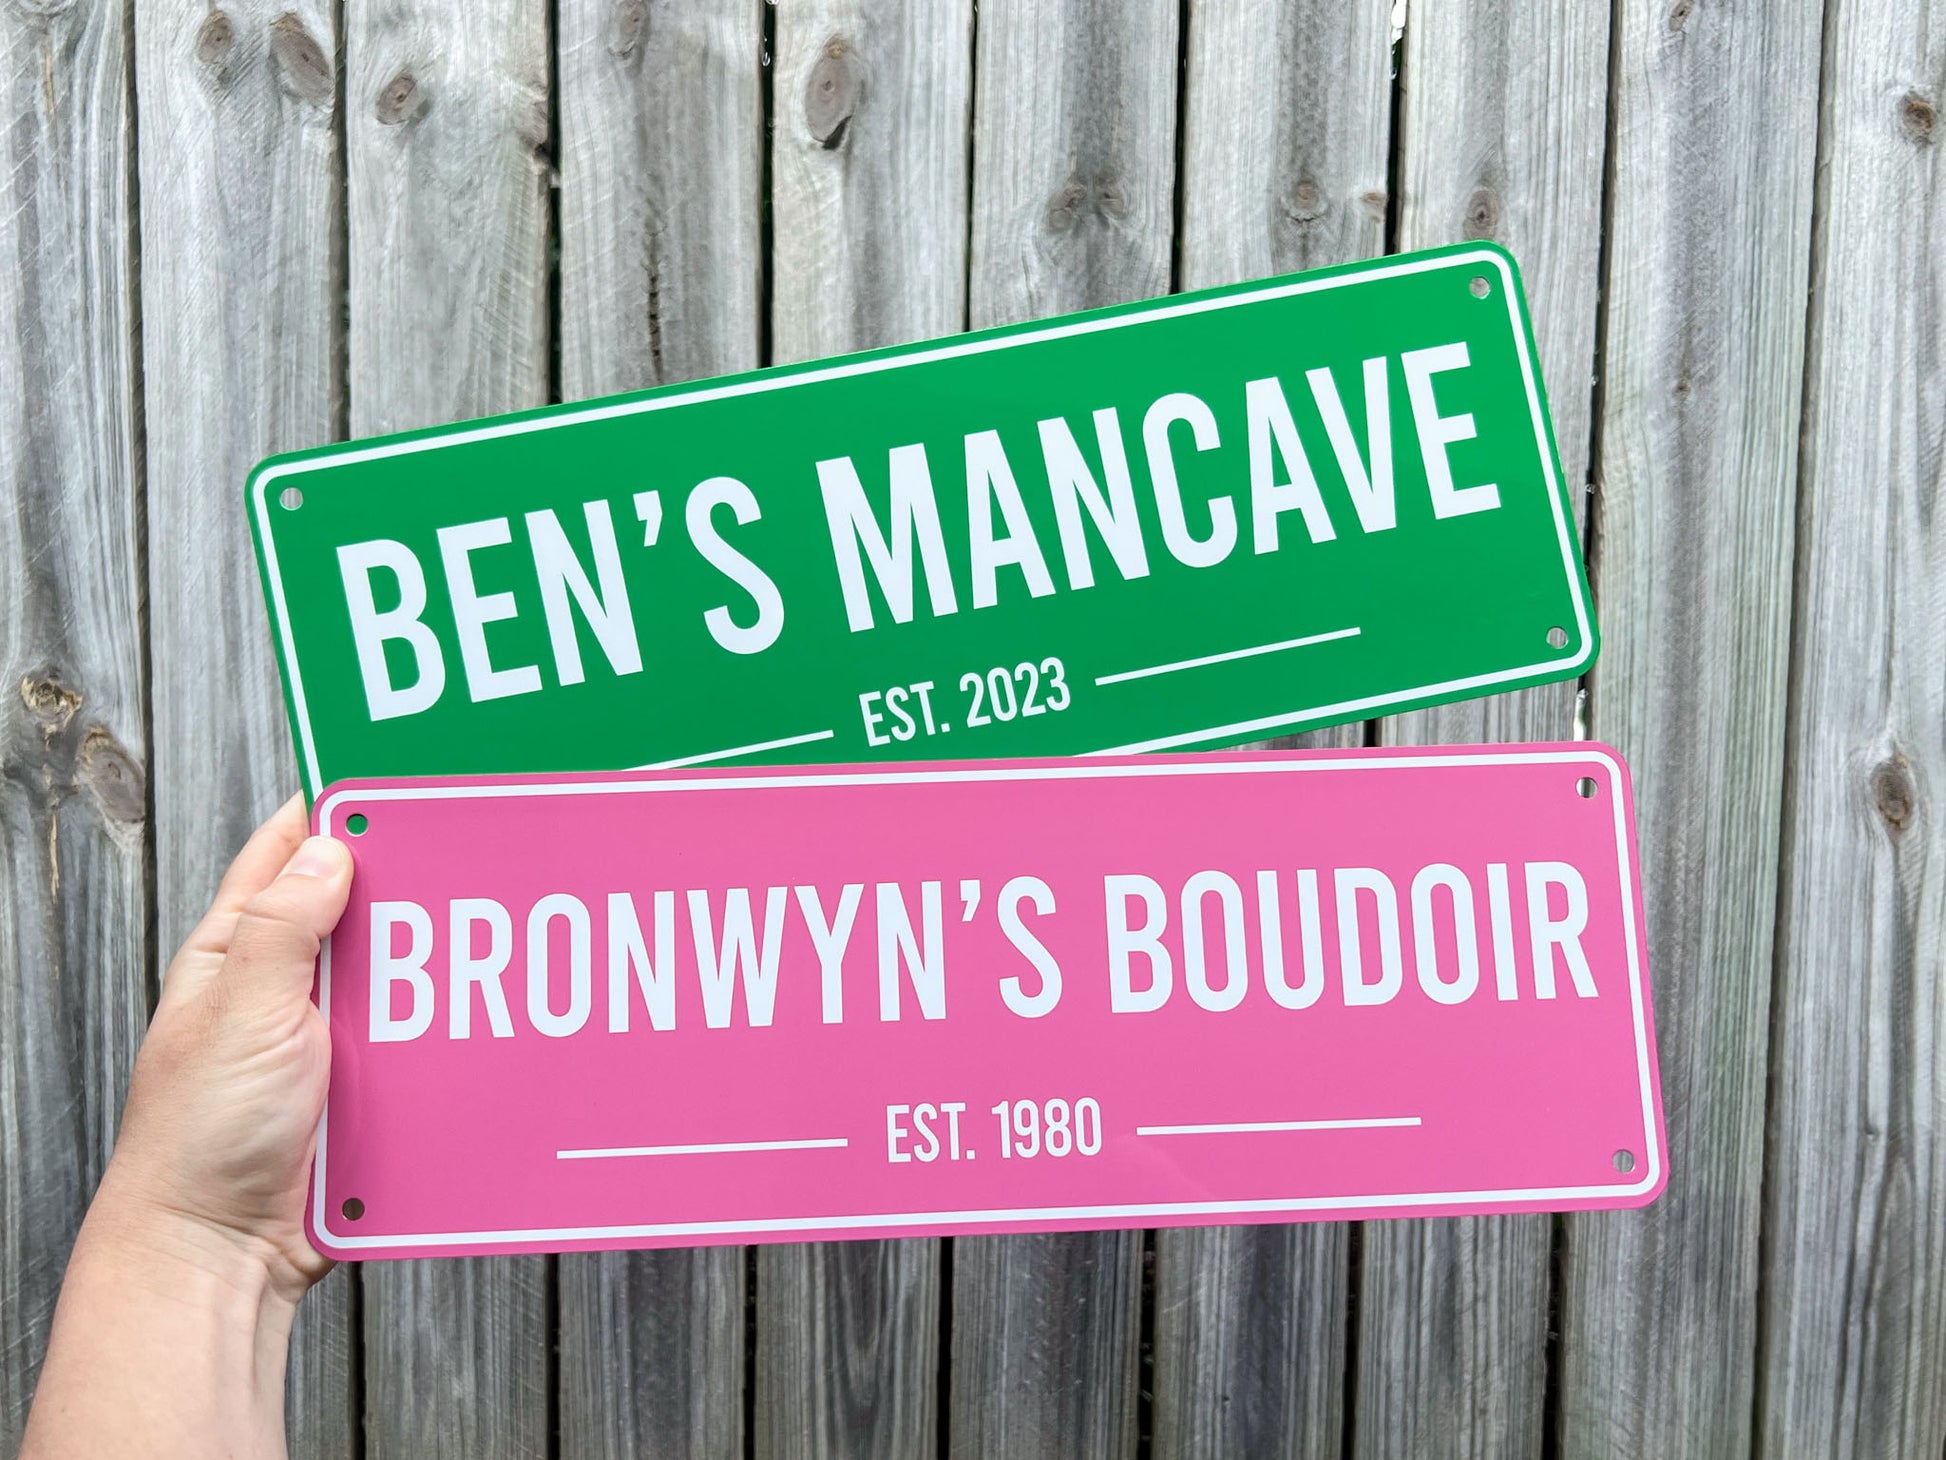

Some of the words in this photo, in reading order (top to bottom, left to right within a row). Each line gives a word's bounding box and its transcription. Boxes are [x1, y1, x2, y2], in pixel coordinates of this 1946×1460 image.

[336, 476, 787, 722] BEN’S
[815, 341, 1502, 634] MANCAVE
[859, 681, 951, 747] EST.
[959, 657, 1072, 728] 2023
[368, 875, 1064, 1043] BRONWYN’S
[1103, 861, 1600, 1015] BOUDOIR
[885, 1100, 977, 1164] EST.
[991, 1097, 1103, 1160] 1980
